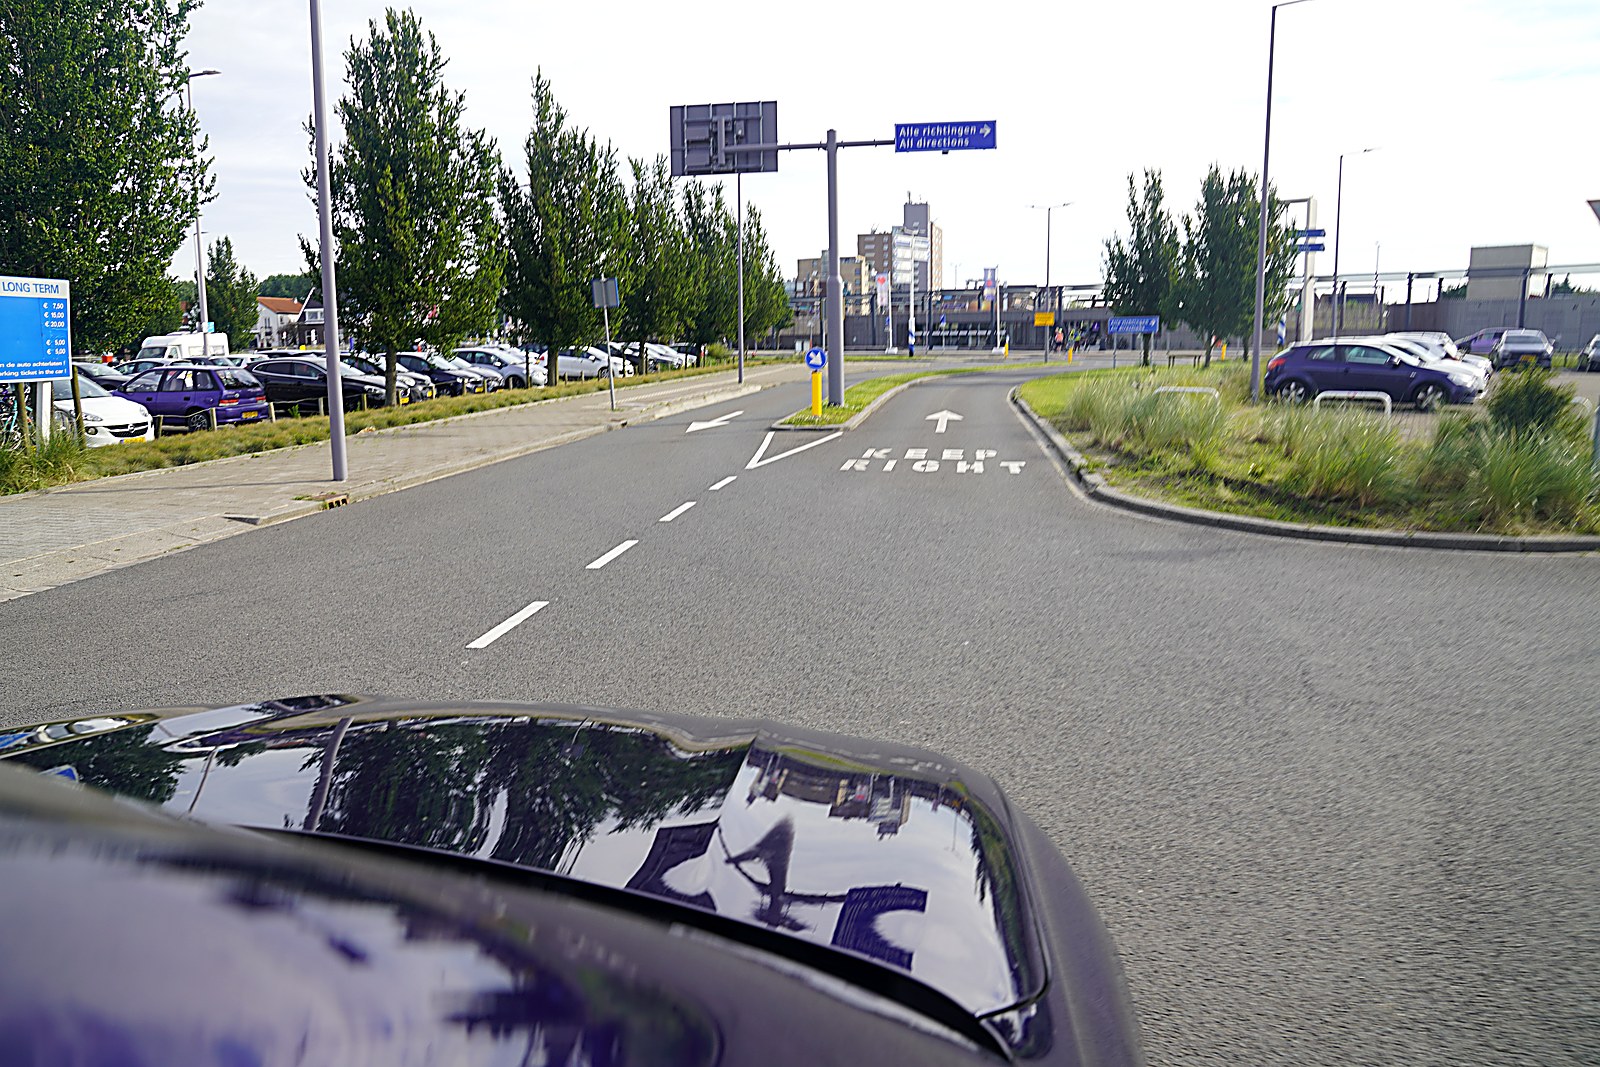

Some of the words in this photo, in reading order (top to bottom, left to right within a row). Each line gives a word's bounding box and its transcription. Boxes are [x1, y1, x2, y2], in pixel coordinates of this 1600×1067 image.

[899, 126, 919, 137] Alle
[922, 124, 977, 138] richtingen
[899, 138, 914, 149] All
[916, 136, 970, 149] directions
[2, 281, 31, 293] LONG
[33, 283, 60, 294] TERM
[861, 447, 998, 461] KEEP
[839, 458, 1027, 475] RIGHT
